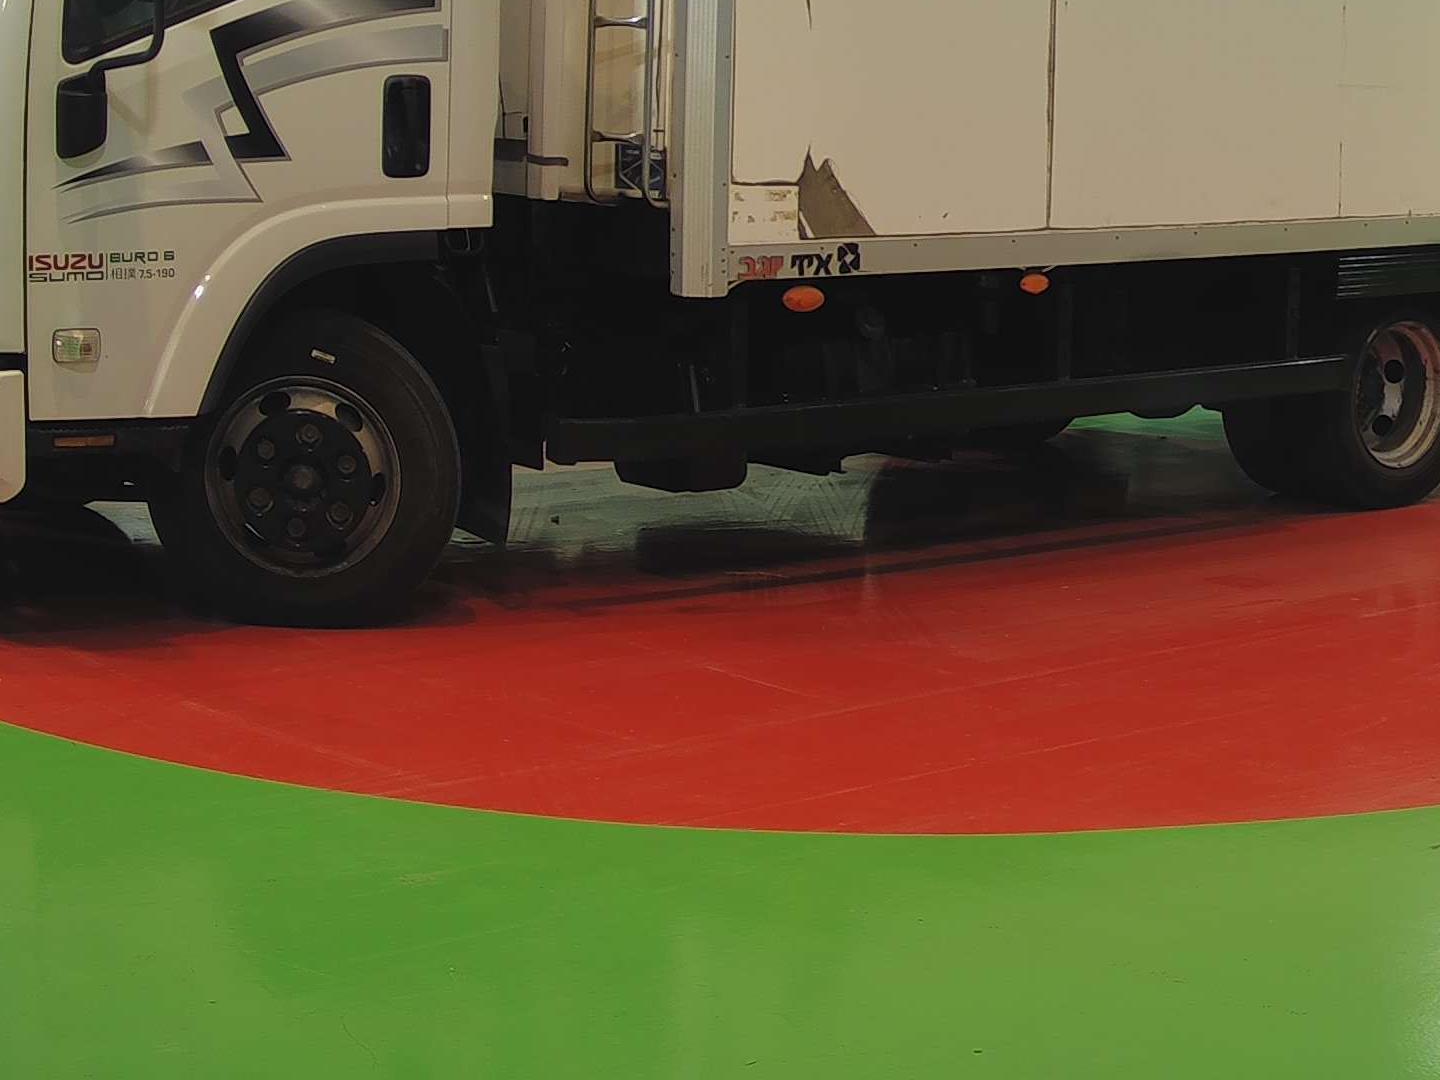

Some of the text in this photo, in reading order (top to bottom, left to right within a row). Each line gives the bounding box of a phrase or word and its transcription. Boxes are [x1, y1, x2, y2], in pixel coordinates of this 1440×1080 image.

[28, 252, 104, 271] ISUZU
[110, 250, 175, 264] EURO 6
[28, 270, 105, 283] SUMO
